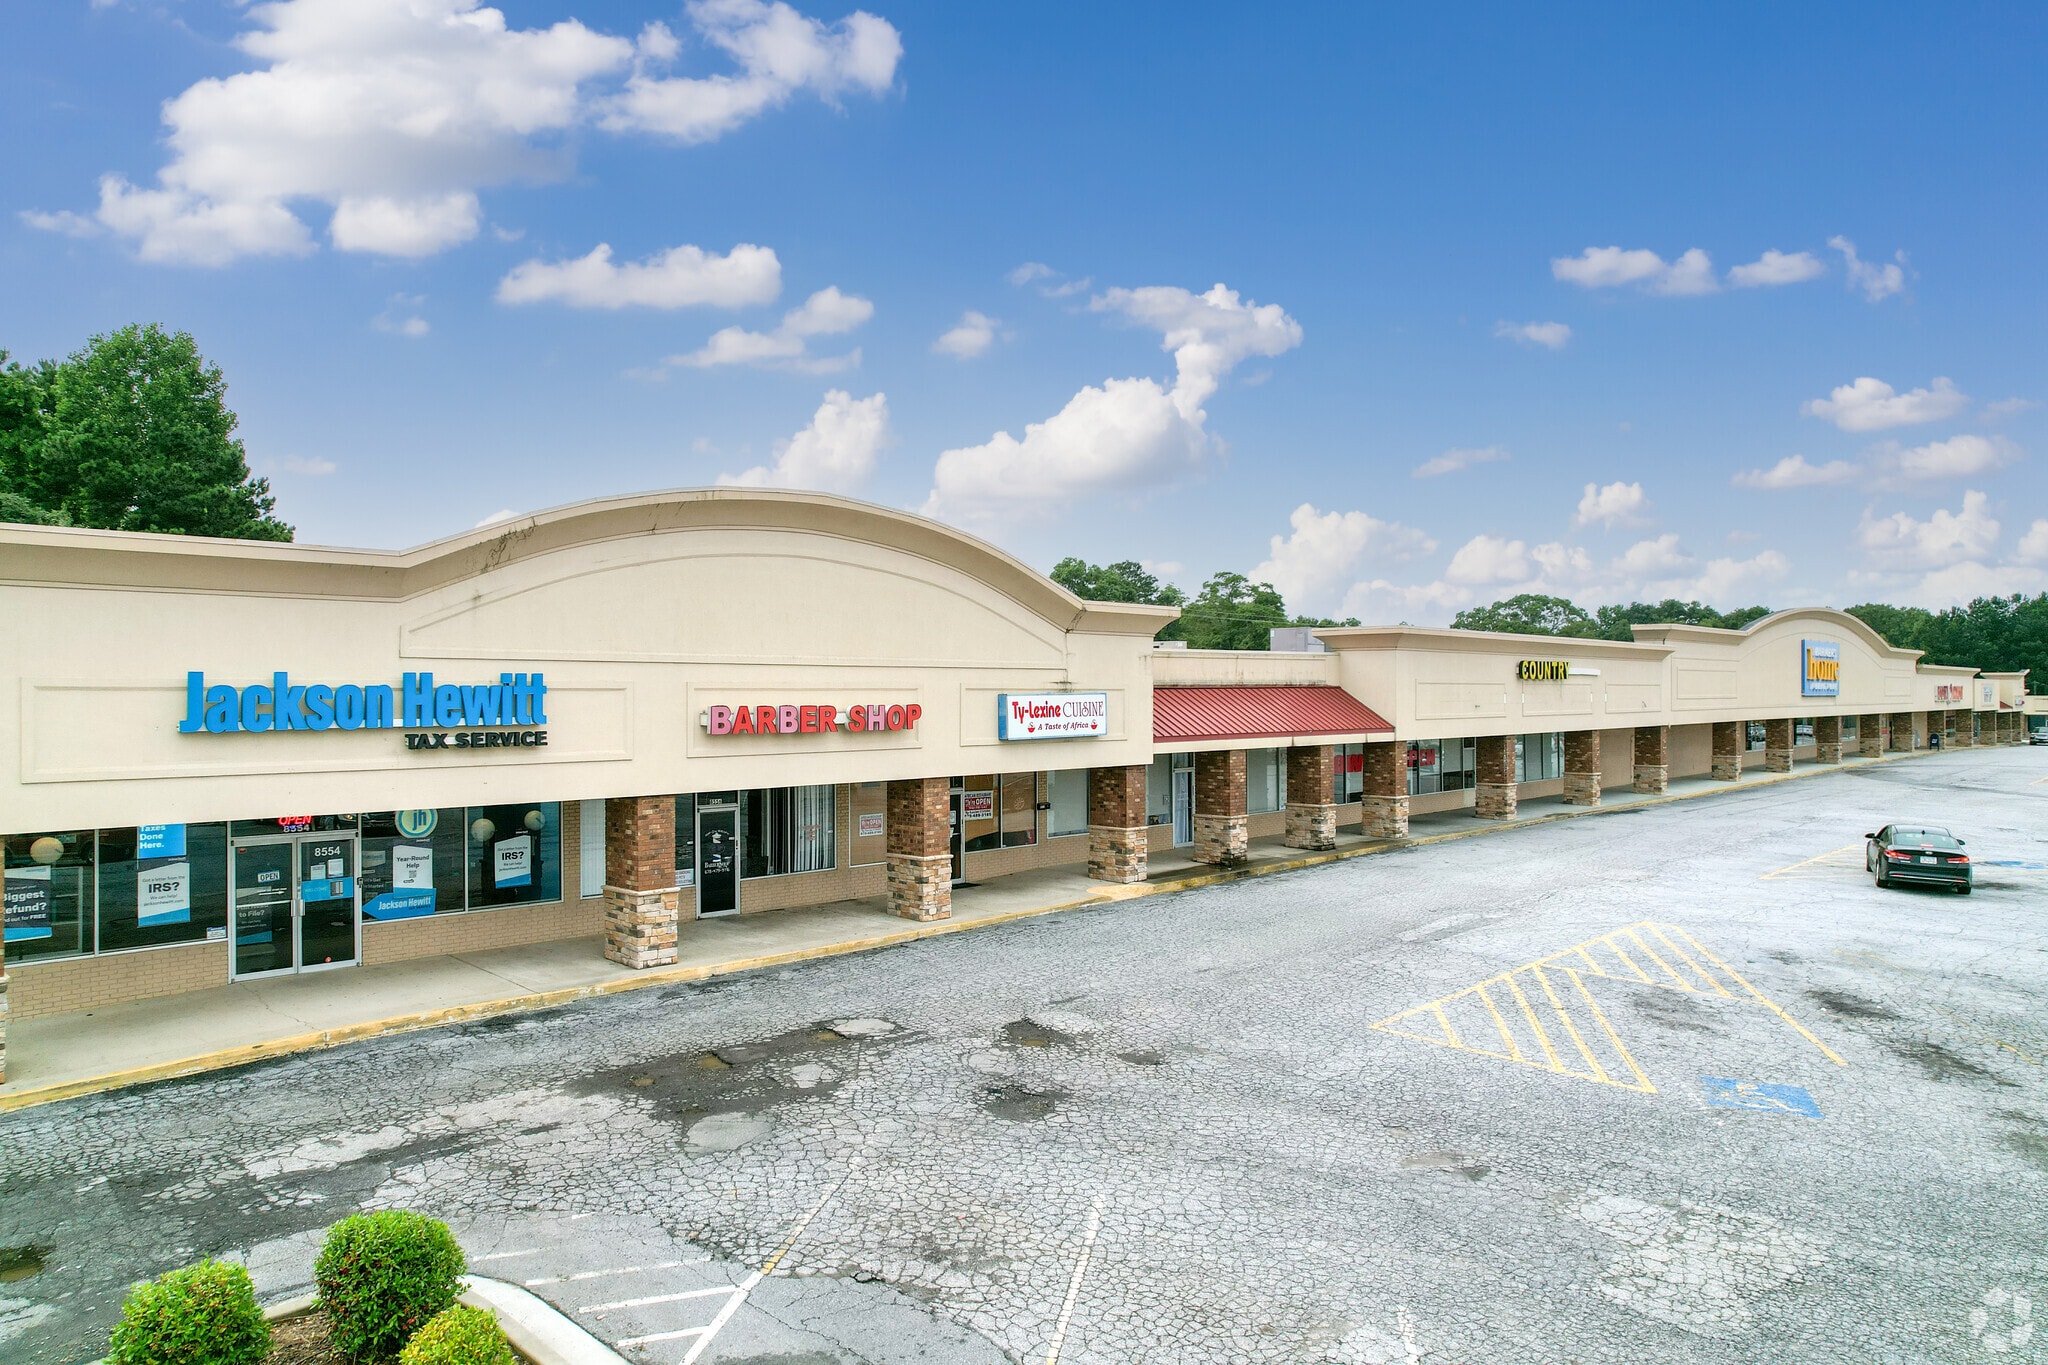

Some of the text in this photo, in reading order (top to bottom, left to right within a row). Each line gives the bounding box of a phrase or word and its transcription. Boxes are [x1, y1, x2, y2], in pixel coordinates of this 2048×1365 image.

[1520, 660, 1570, 680] COUNTRY
[1807, 648, 1840, 680] home
[180, 671, 548, 733] Jackson Hewitt
[1012, 700, 1104, 724] Ty-Lexine CUISINE
[708, 704, 922, 735] BARBER SHOP
[1038, 721, 1089, 731] A Taste of Africa
[405, 730, 549, 750] TAX SERVICE
[1406, 748, 1435, 767] PEN
[278, 815, 313, 825] OPEN
[412, 810, 427, 831] jh
[283, 824, 310, 833] 8554
[140, 833, 163, 841] Done
[140, 842, 165, 850] Here.
[314, 846, 341, 857] 8554
[396, 854, 430, 862] Year-Round
[502, 851, 524, 861] IRS?
[260, 872, 279, 881] OPEN
[148, 881, 180, 893] IRS?
[4, 902, 47, 914] efund?
[378, 896, 431, 911] Jackson Hewitt
